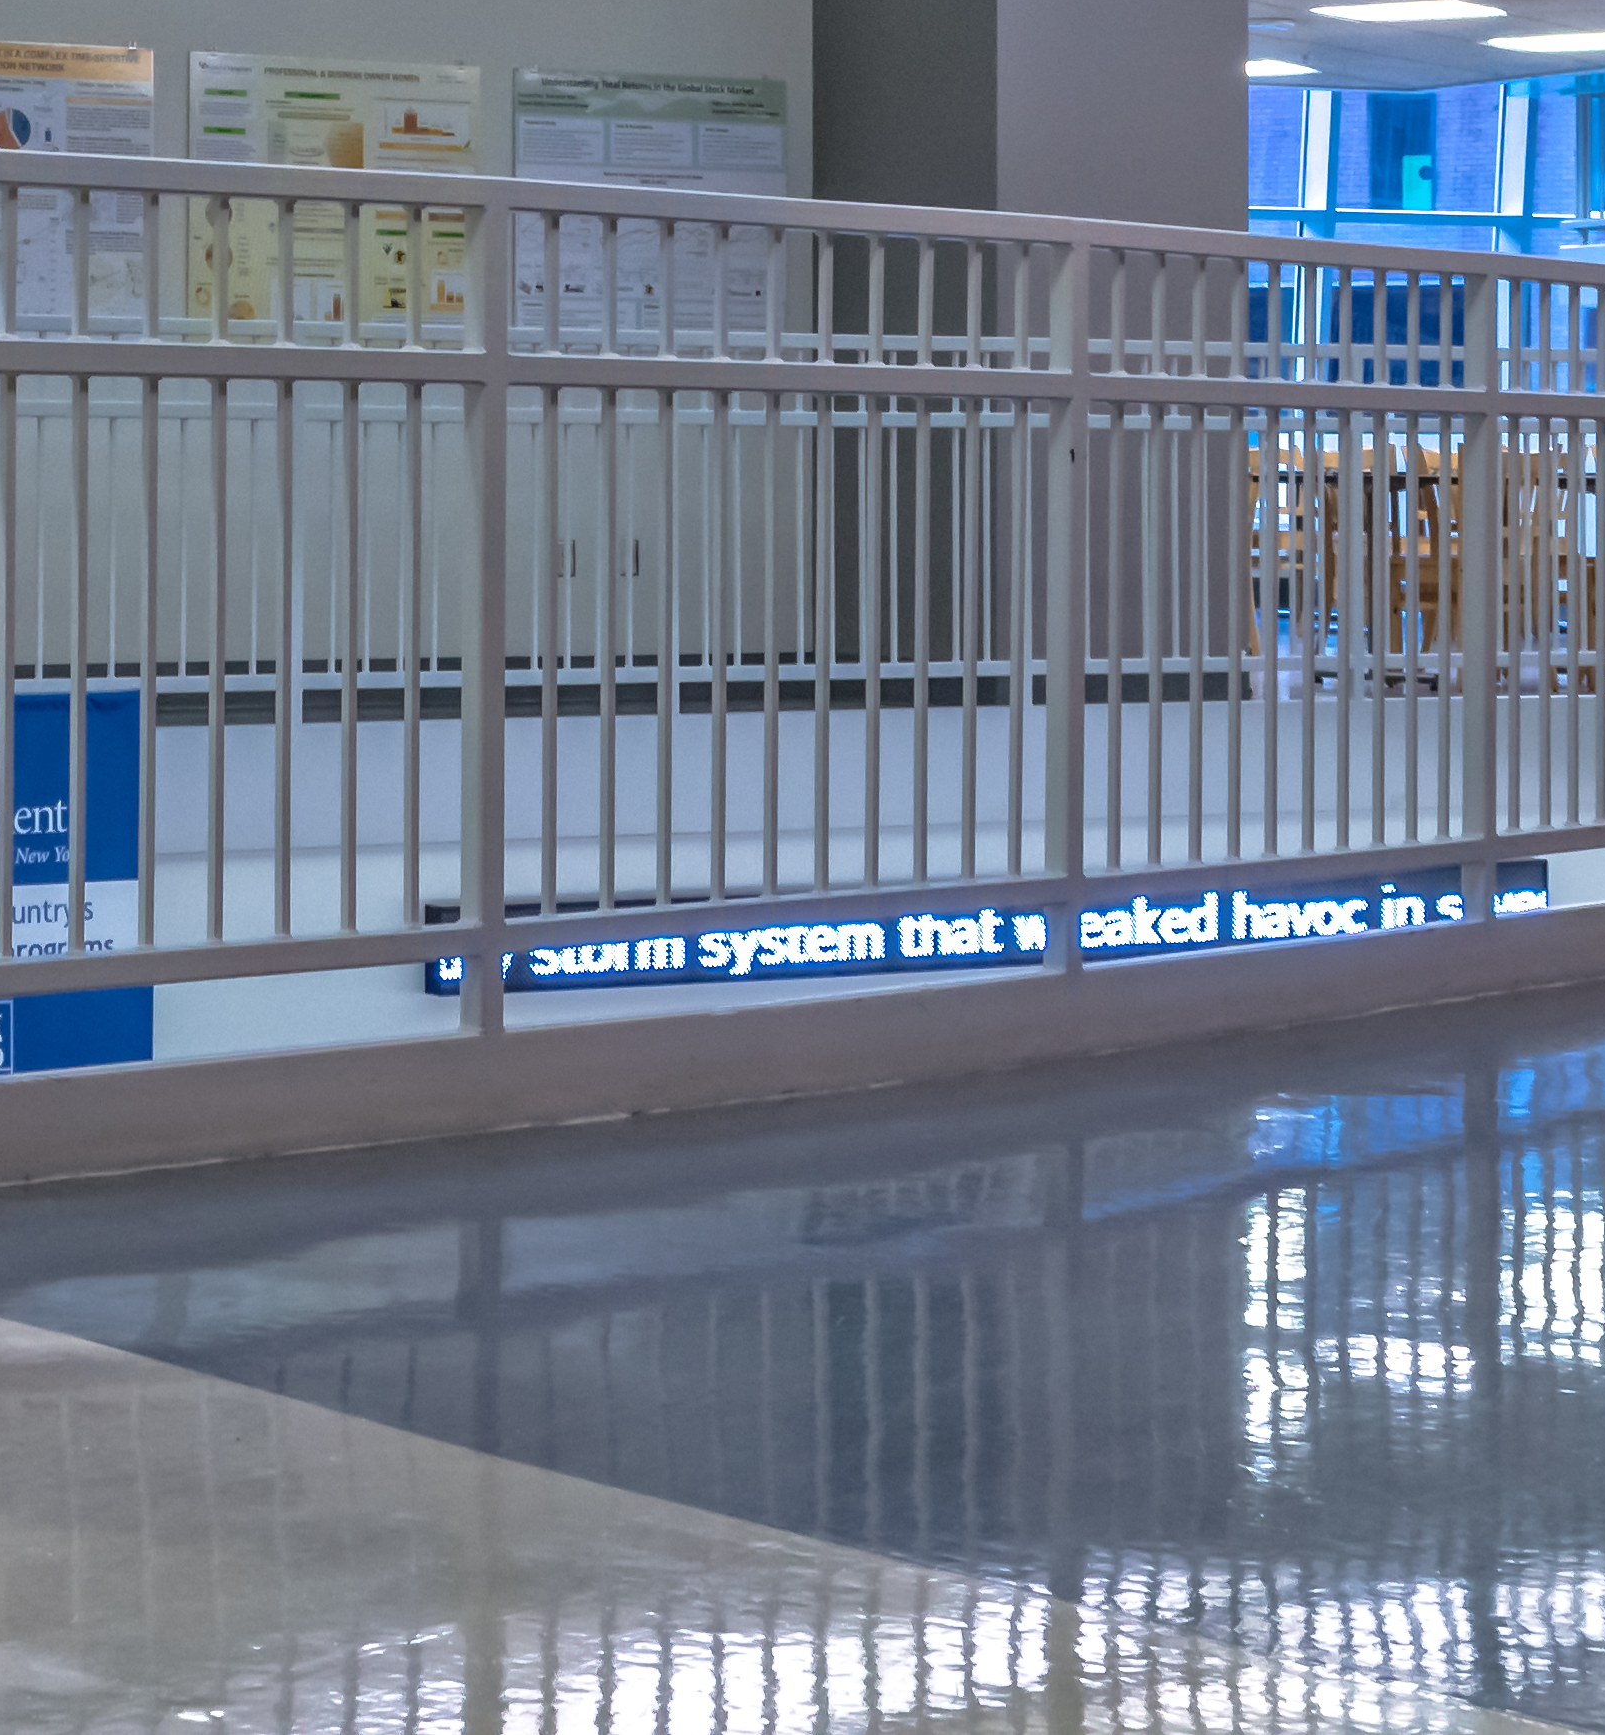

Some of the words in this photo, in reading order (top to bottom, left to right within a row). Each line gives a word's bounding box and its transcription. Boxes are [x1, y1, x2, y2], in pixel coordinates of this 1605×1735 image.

[23, 50, 68, 60] COMPLEX
[18, 62, 65, 72] NETWORK
[264, 66, 318, 77] PROFESSIONAL
[15, 847, 50, 865] New
[697, 921, 887, 976] system
[897, 907, 1006, 959] that
[1010, 890, 1219, 952] weaked
[1231, 889, 1369, 940] havoc
[1379, 881, 1427, 931] in
